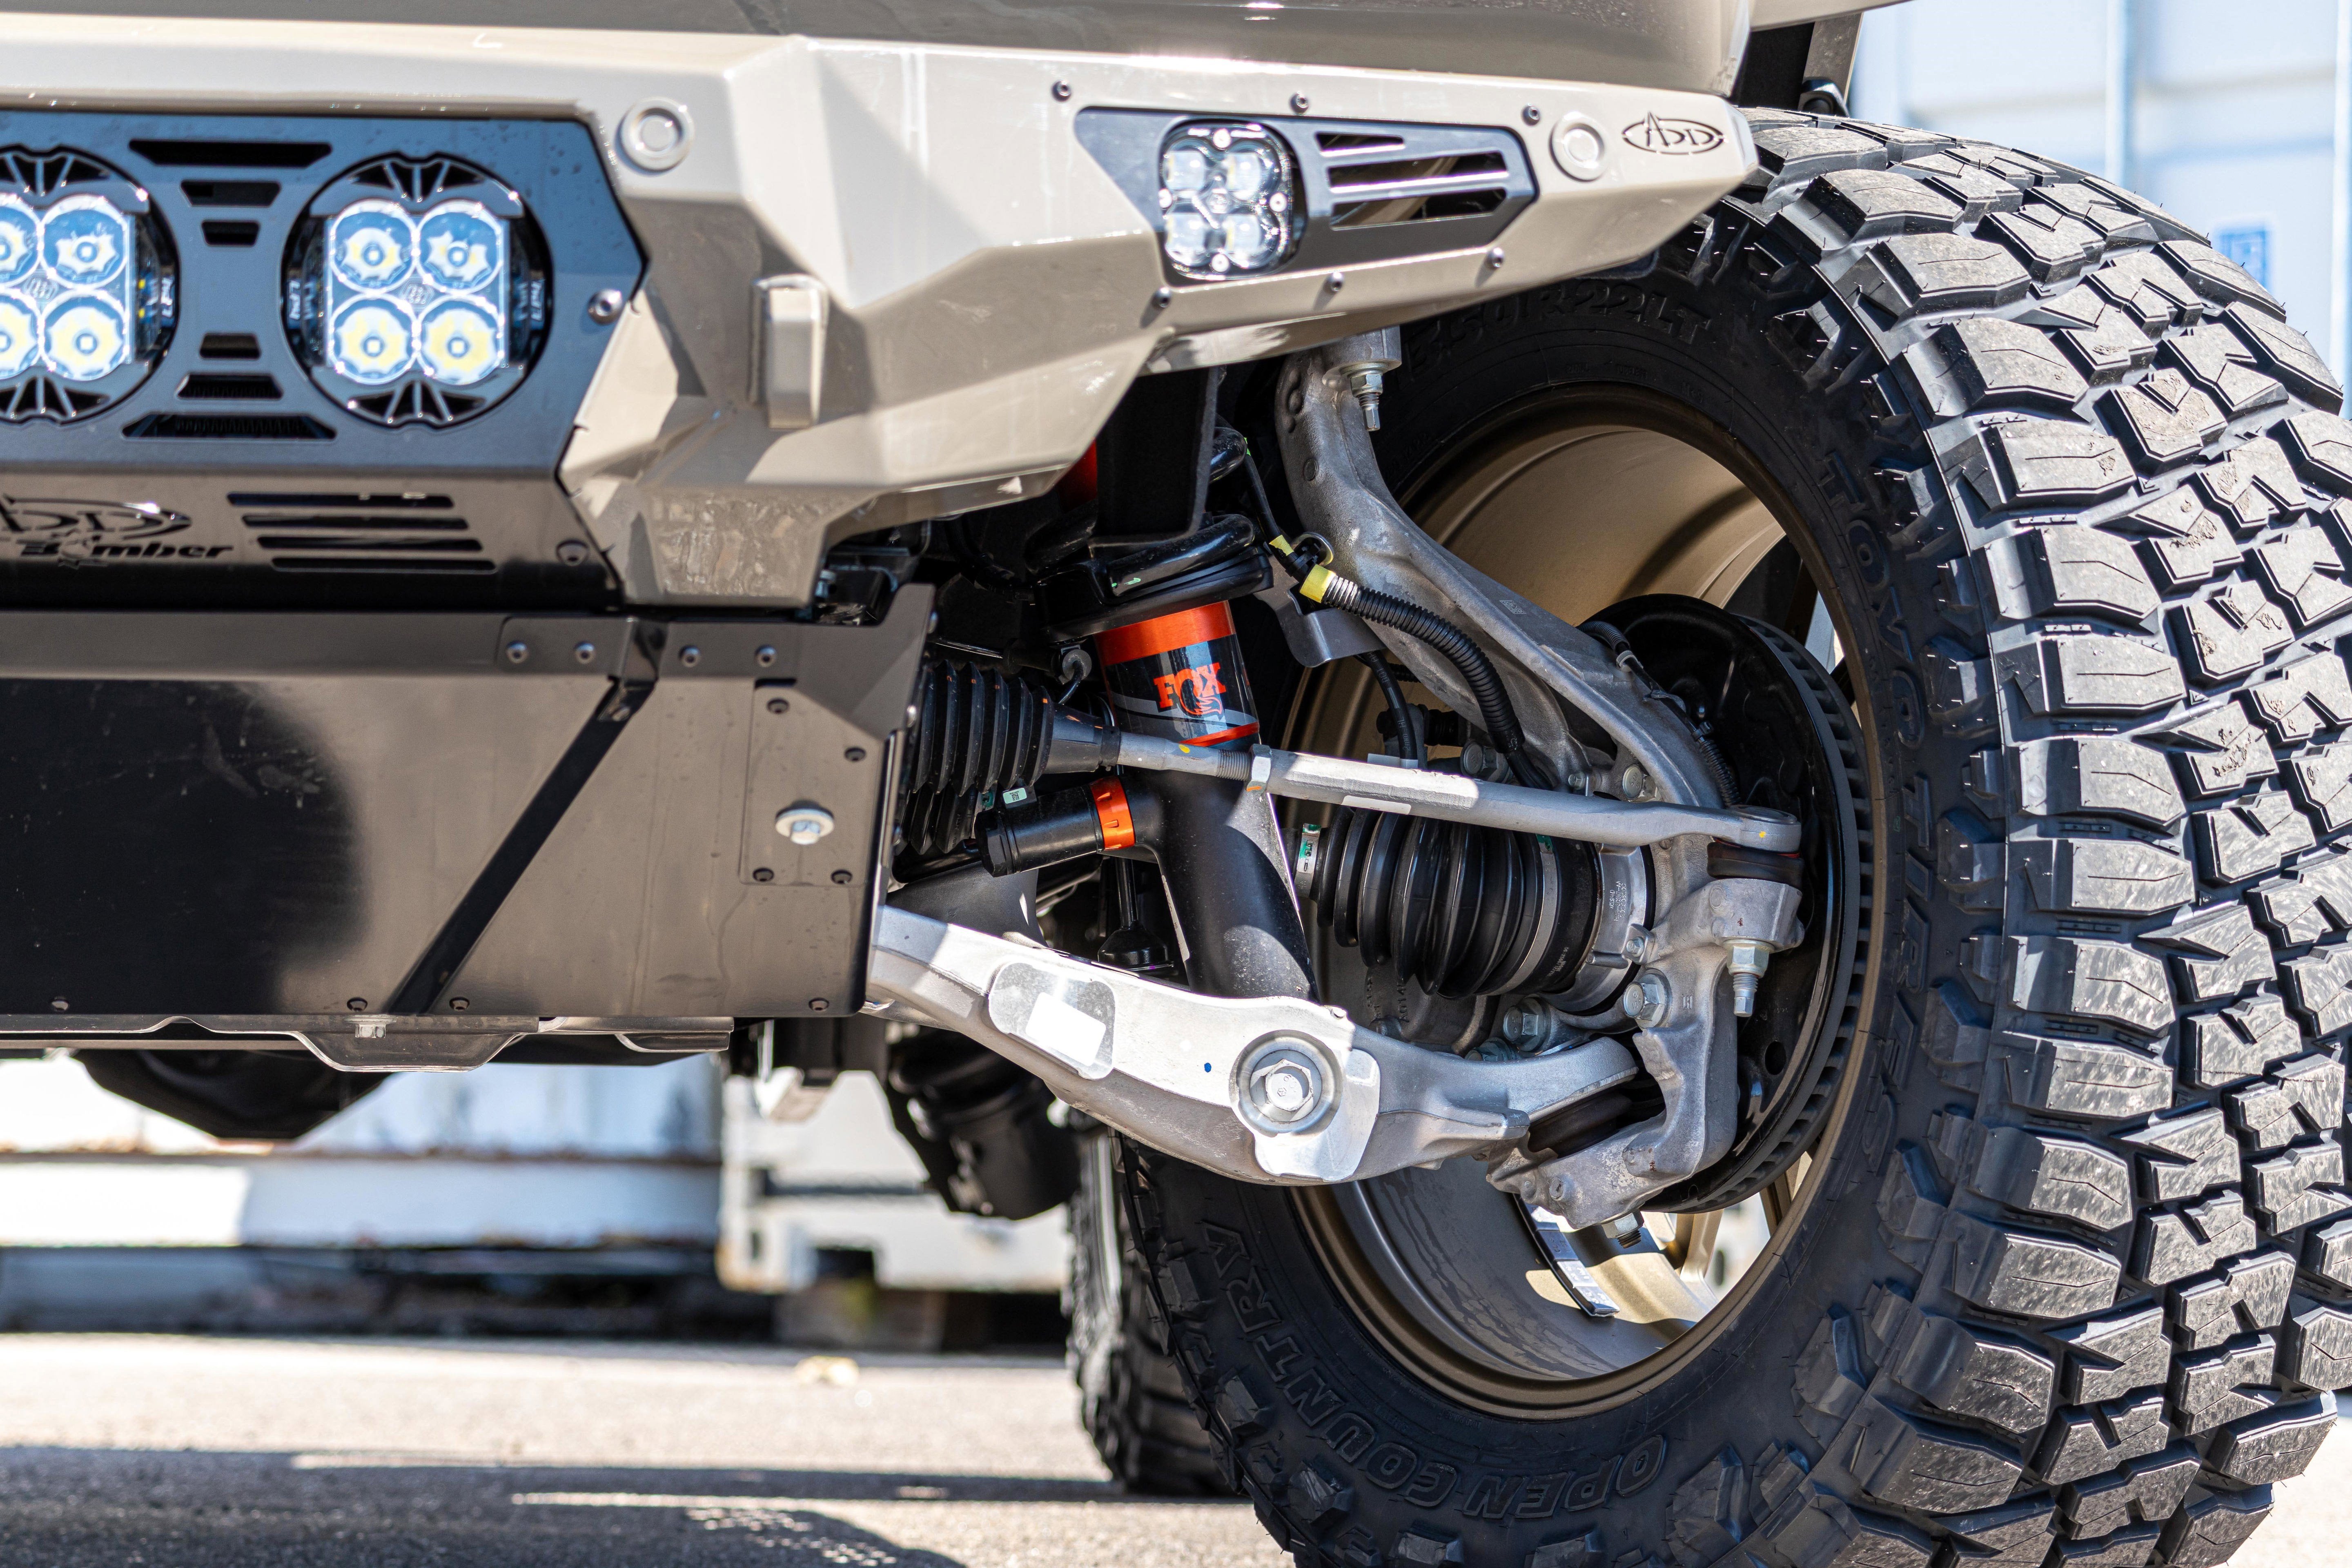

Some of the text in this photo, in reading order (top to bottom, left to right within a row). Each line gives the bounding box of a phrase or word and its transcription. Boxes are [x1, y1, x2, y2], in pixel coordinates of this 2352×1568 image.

[1154, 662, 1227, 715] FOX
[1817, 449, 1931, 1178] TOYO TIRES
[1201, 1220, 1459, 1508] COUNTRY
[1462, 1433, 1665, 1519] OPEN
